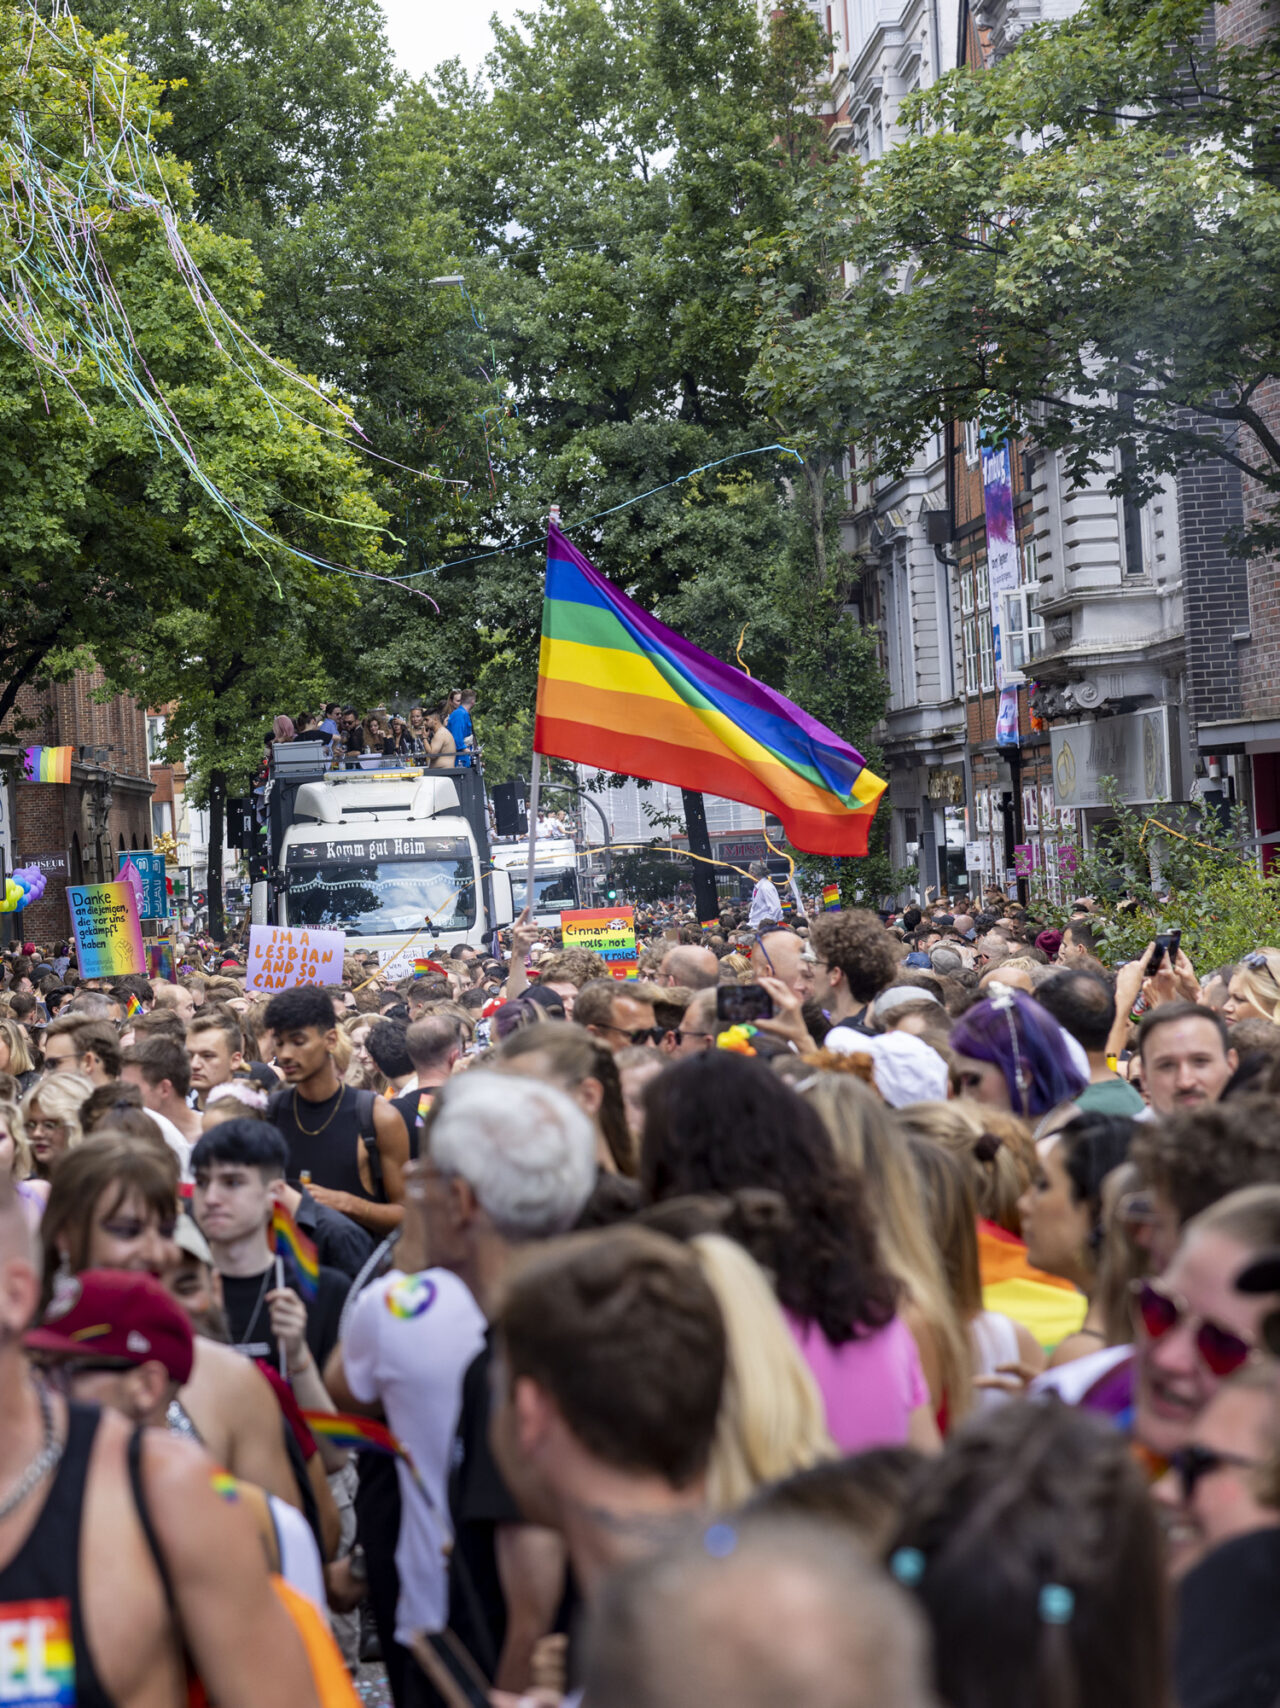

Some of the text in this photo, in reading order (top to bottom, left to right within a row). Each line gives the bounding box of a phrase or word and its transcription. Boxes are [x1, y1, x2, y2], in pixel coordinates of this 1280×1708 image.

[326, 838, 426, 860] Komm gut Heim
[72, 890, 111, 907] Danke
[77, 917, 91, 927] die
[109, 915, 126, 923] uns
[80, 924, 118, 939] gekämpft
[299, 931, 310, 946] A
[81, 939, 106, 949] haben
[608, 938, 626, 947] not
[254, 944, 334, 964] LESBIAN
[261, 959, 317, 978] AND SO
[253, 974, 287, 989] CAN
